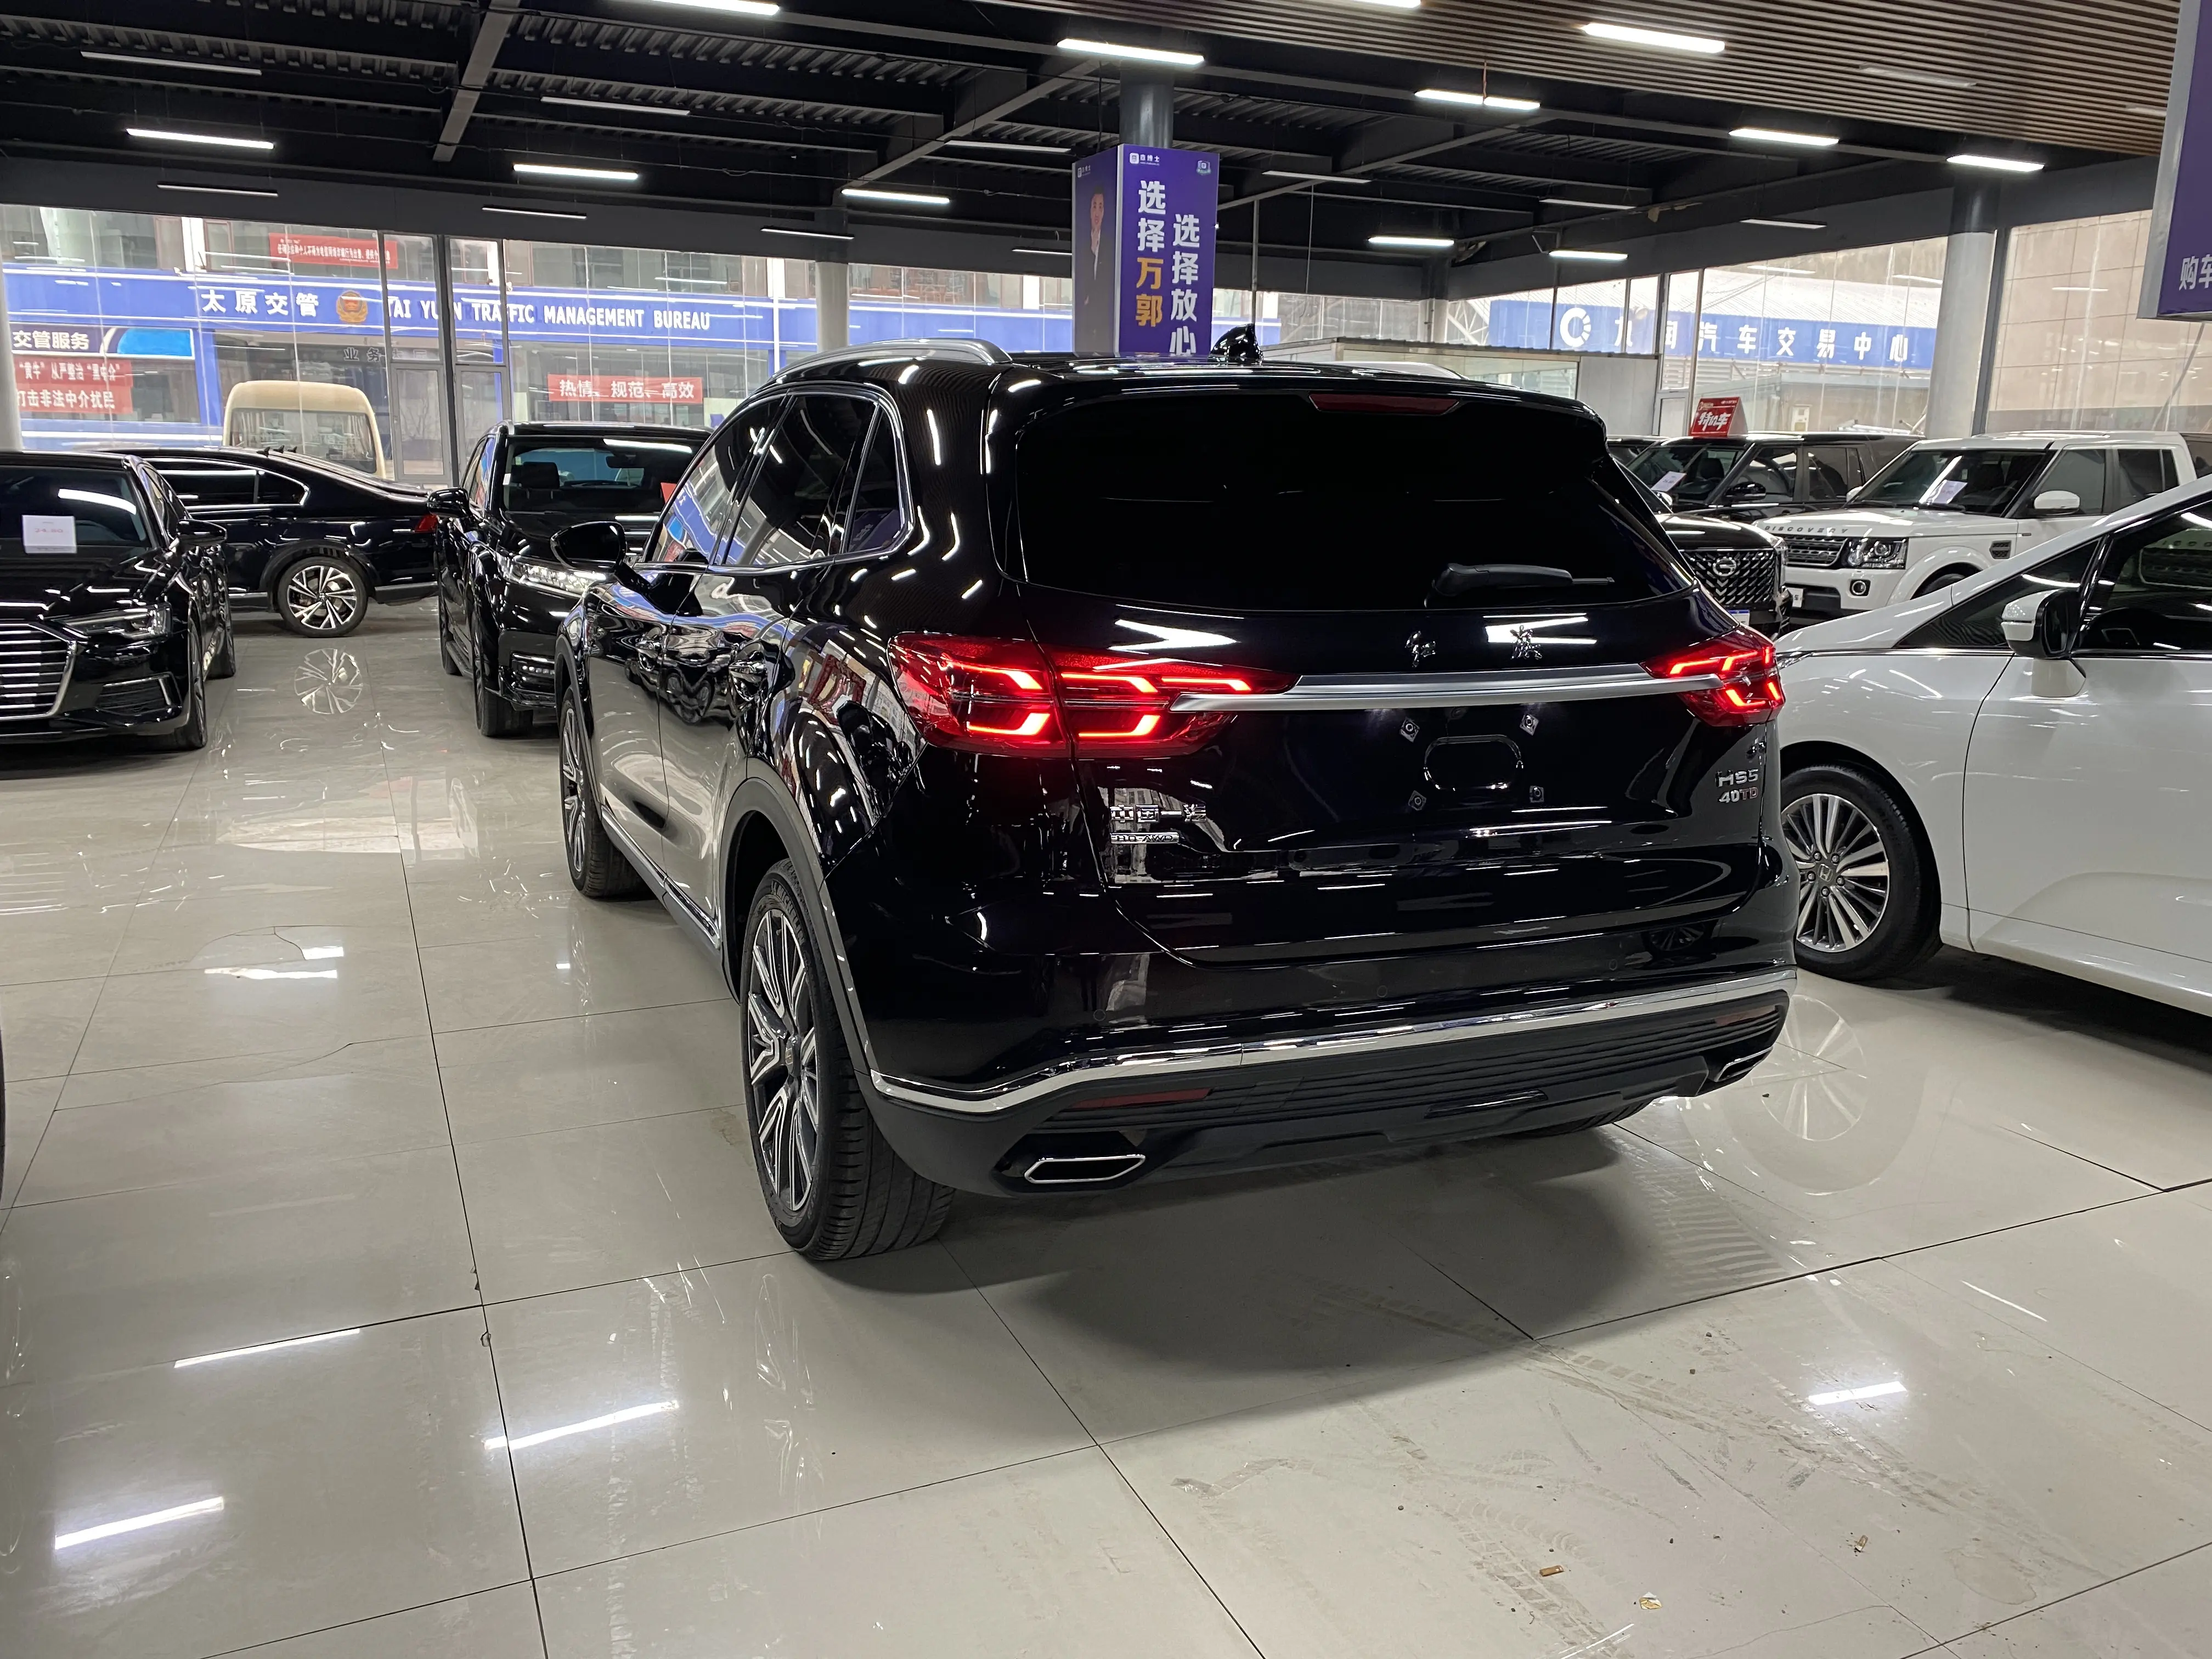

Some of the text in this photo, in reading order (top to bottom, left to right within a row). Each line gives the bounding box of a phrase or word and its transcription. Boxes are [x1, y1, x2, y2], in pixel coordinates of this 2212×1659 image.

[1169, 213, 1200, 356] 选择放心
[201, 289, 319, 317] 太原交管
[420, 300, 462, 321] YUN
[472, 302, 534, 323] TRAFIC
[544, 305, 645, 328] MANAGEMENT
[653, 309, 710, 330] BUREAU
[12, 330, 90, 351] 交管服务
[1697, 411, 1731, 432] 特价车
[1764, 526, 1849, 534] DISCOVERY
[1715, 769, 1759, 787] HS5
[1718, 787, 1759, 803] 40TD
[1109, 804, 1206, 823] 中国一汽
